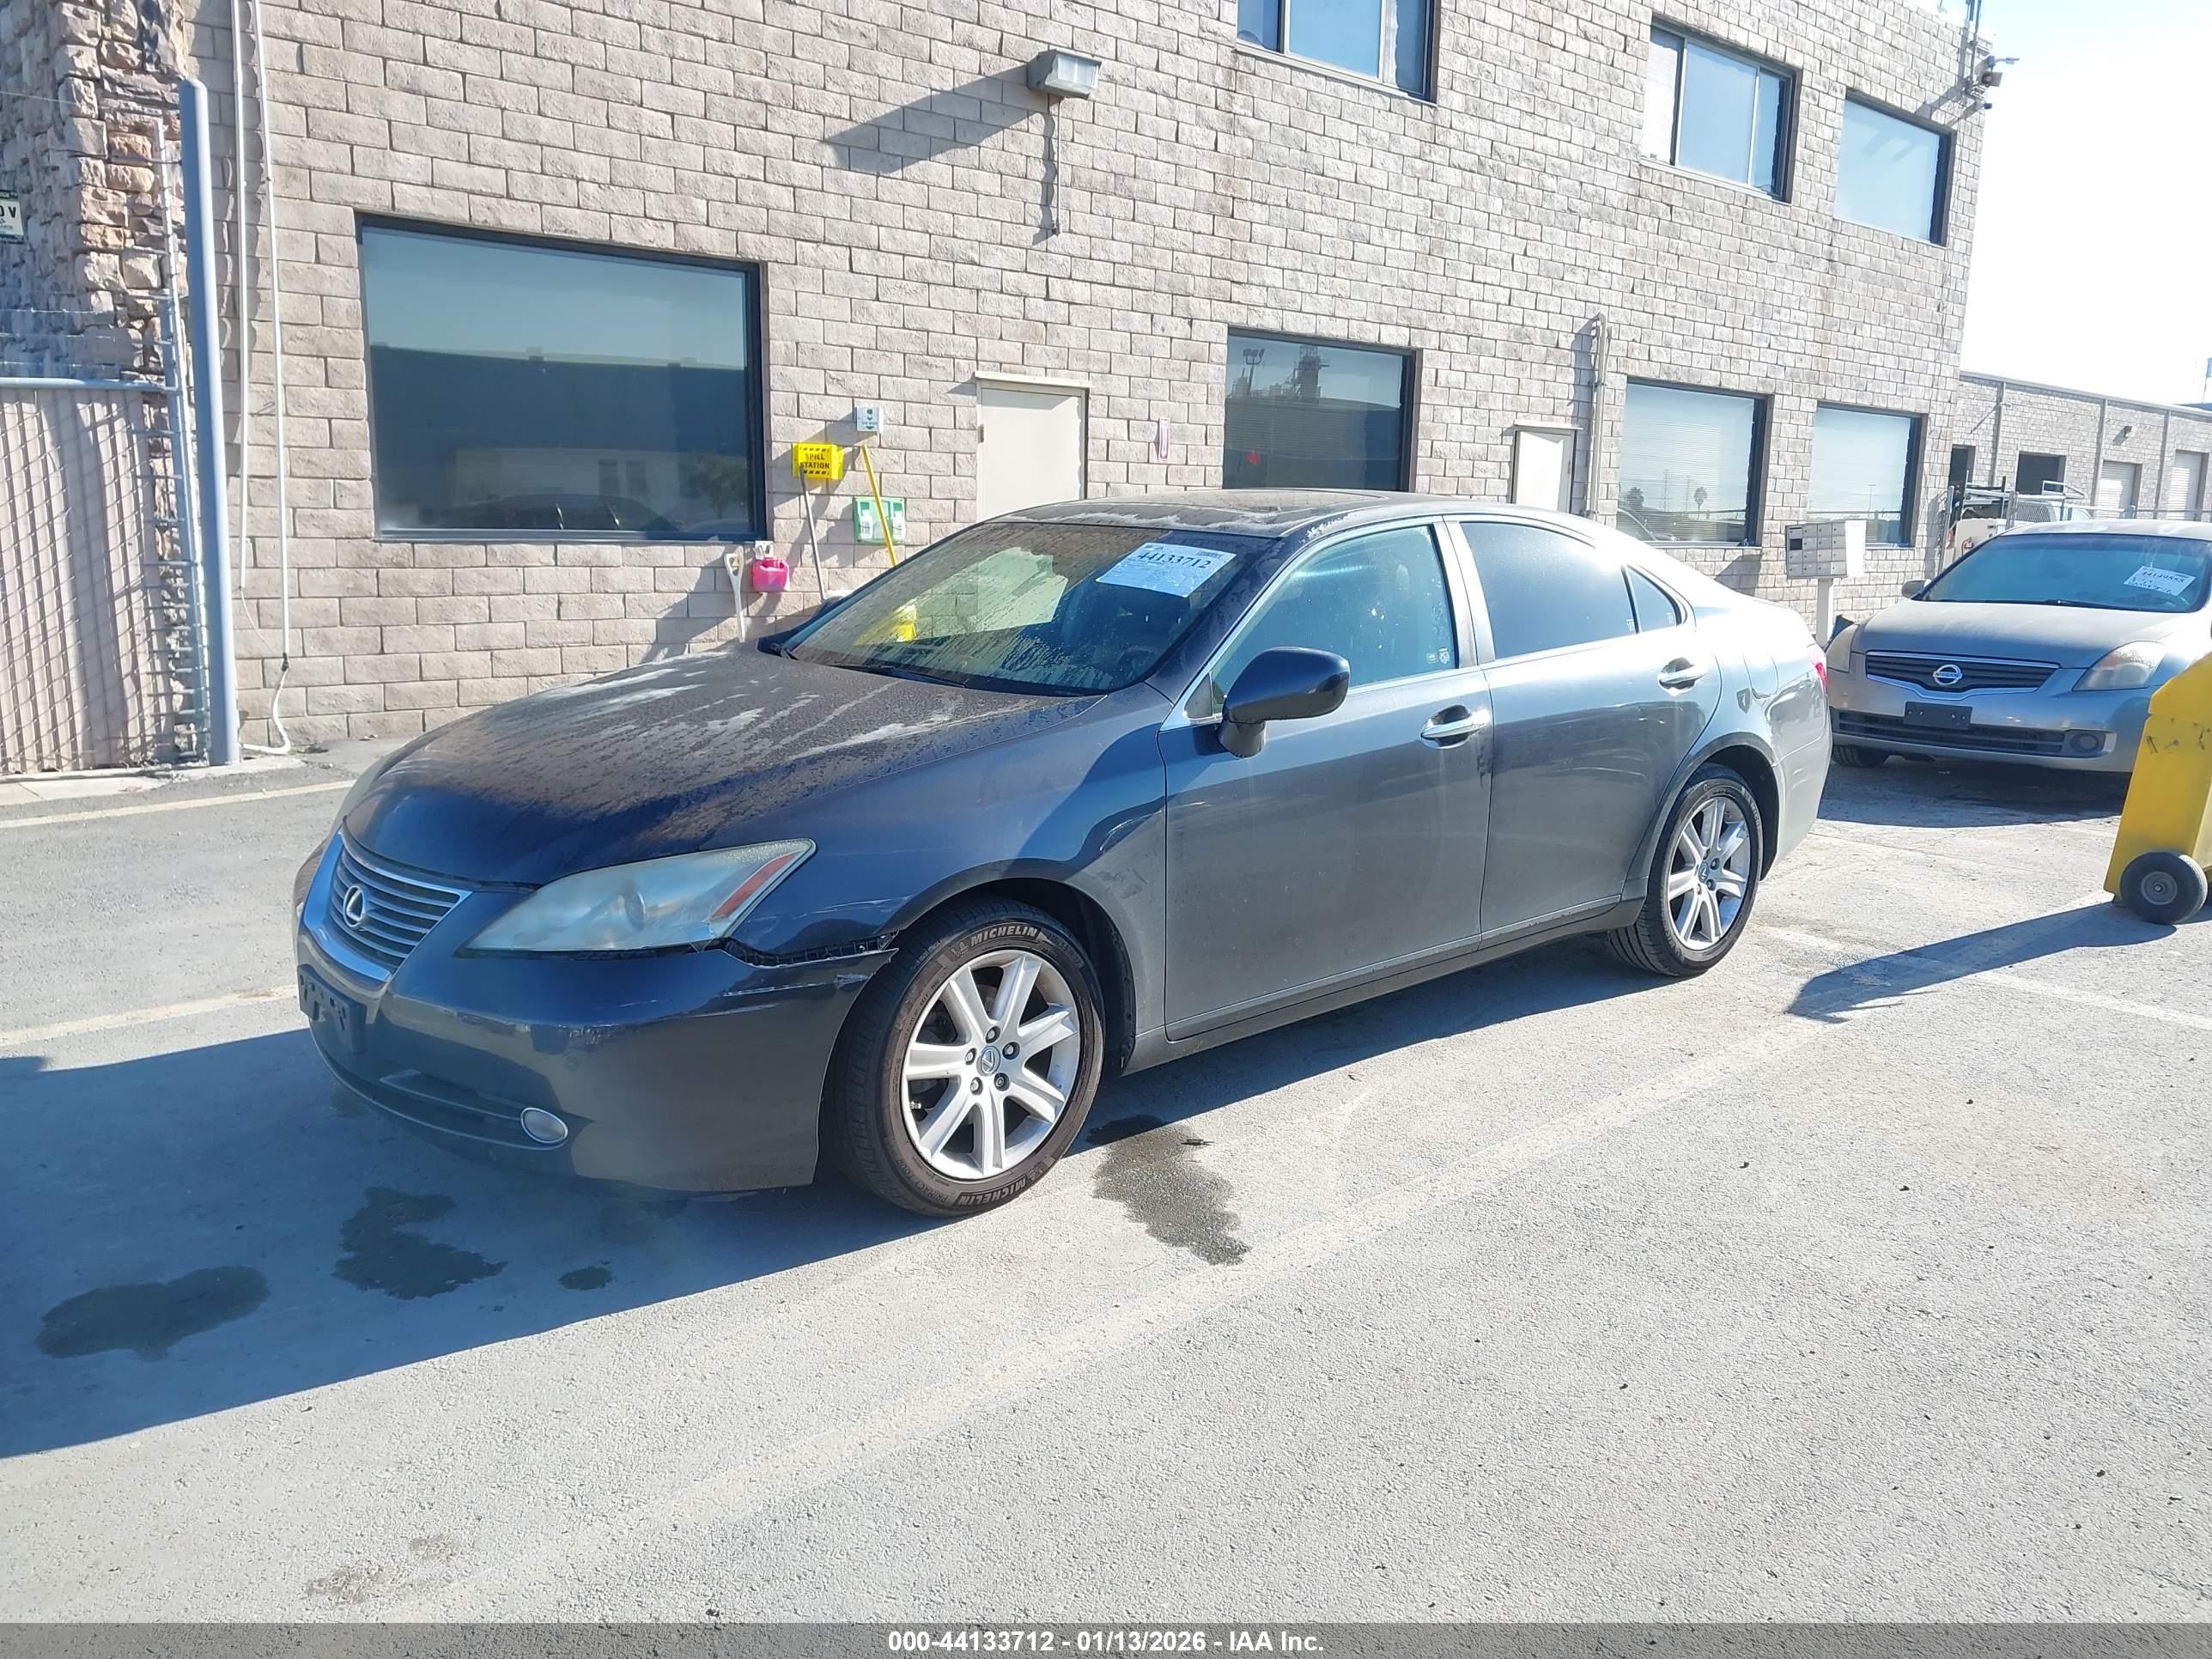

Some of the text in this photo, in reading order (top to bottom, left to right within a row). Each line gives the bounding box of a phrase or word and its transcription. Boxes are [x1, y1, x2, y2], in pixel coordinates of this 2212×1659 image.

[8, 206, 16, 218] V
[1137, 550, 1212, 568] 44133712
[969, 925, 1038, 947] MICHELIN
[957, 1178, 1027, 1206] MICHELIN
